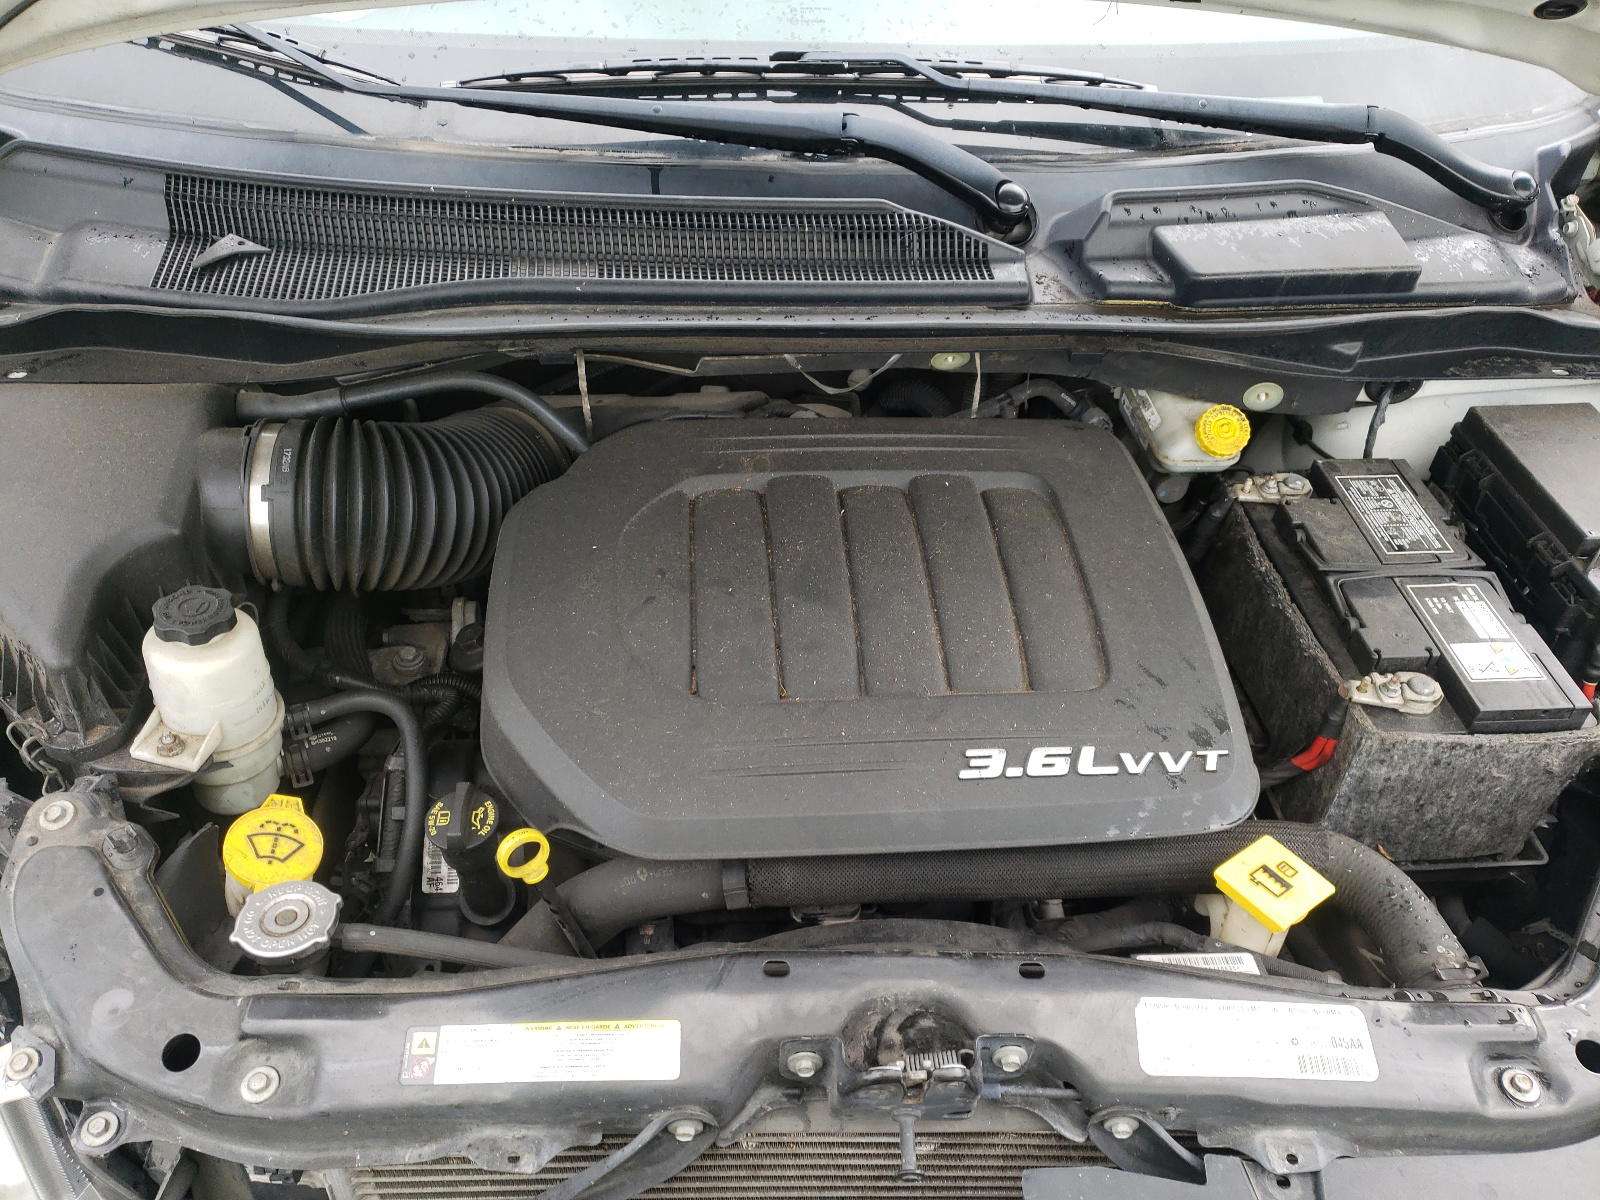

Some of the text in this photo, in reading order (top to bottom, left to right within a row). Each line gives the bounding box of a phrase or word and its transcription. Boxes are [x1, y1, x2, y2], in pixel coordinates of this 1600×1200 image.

[431, 801, 444, 816] SAE
[477, 800, 495, 837] ENGINE OIL
